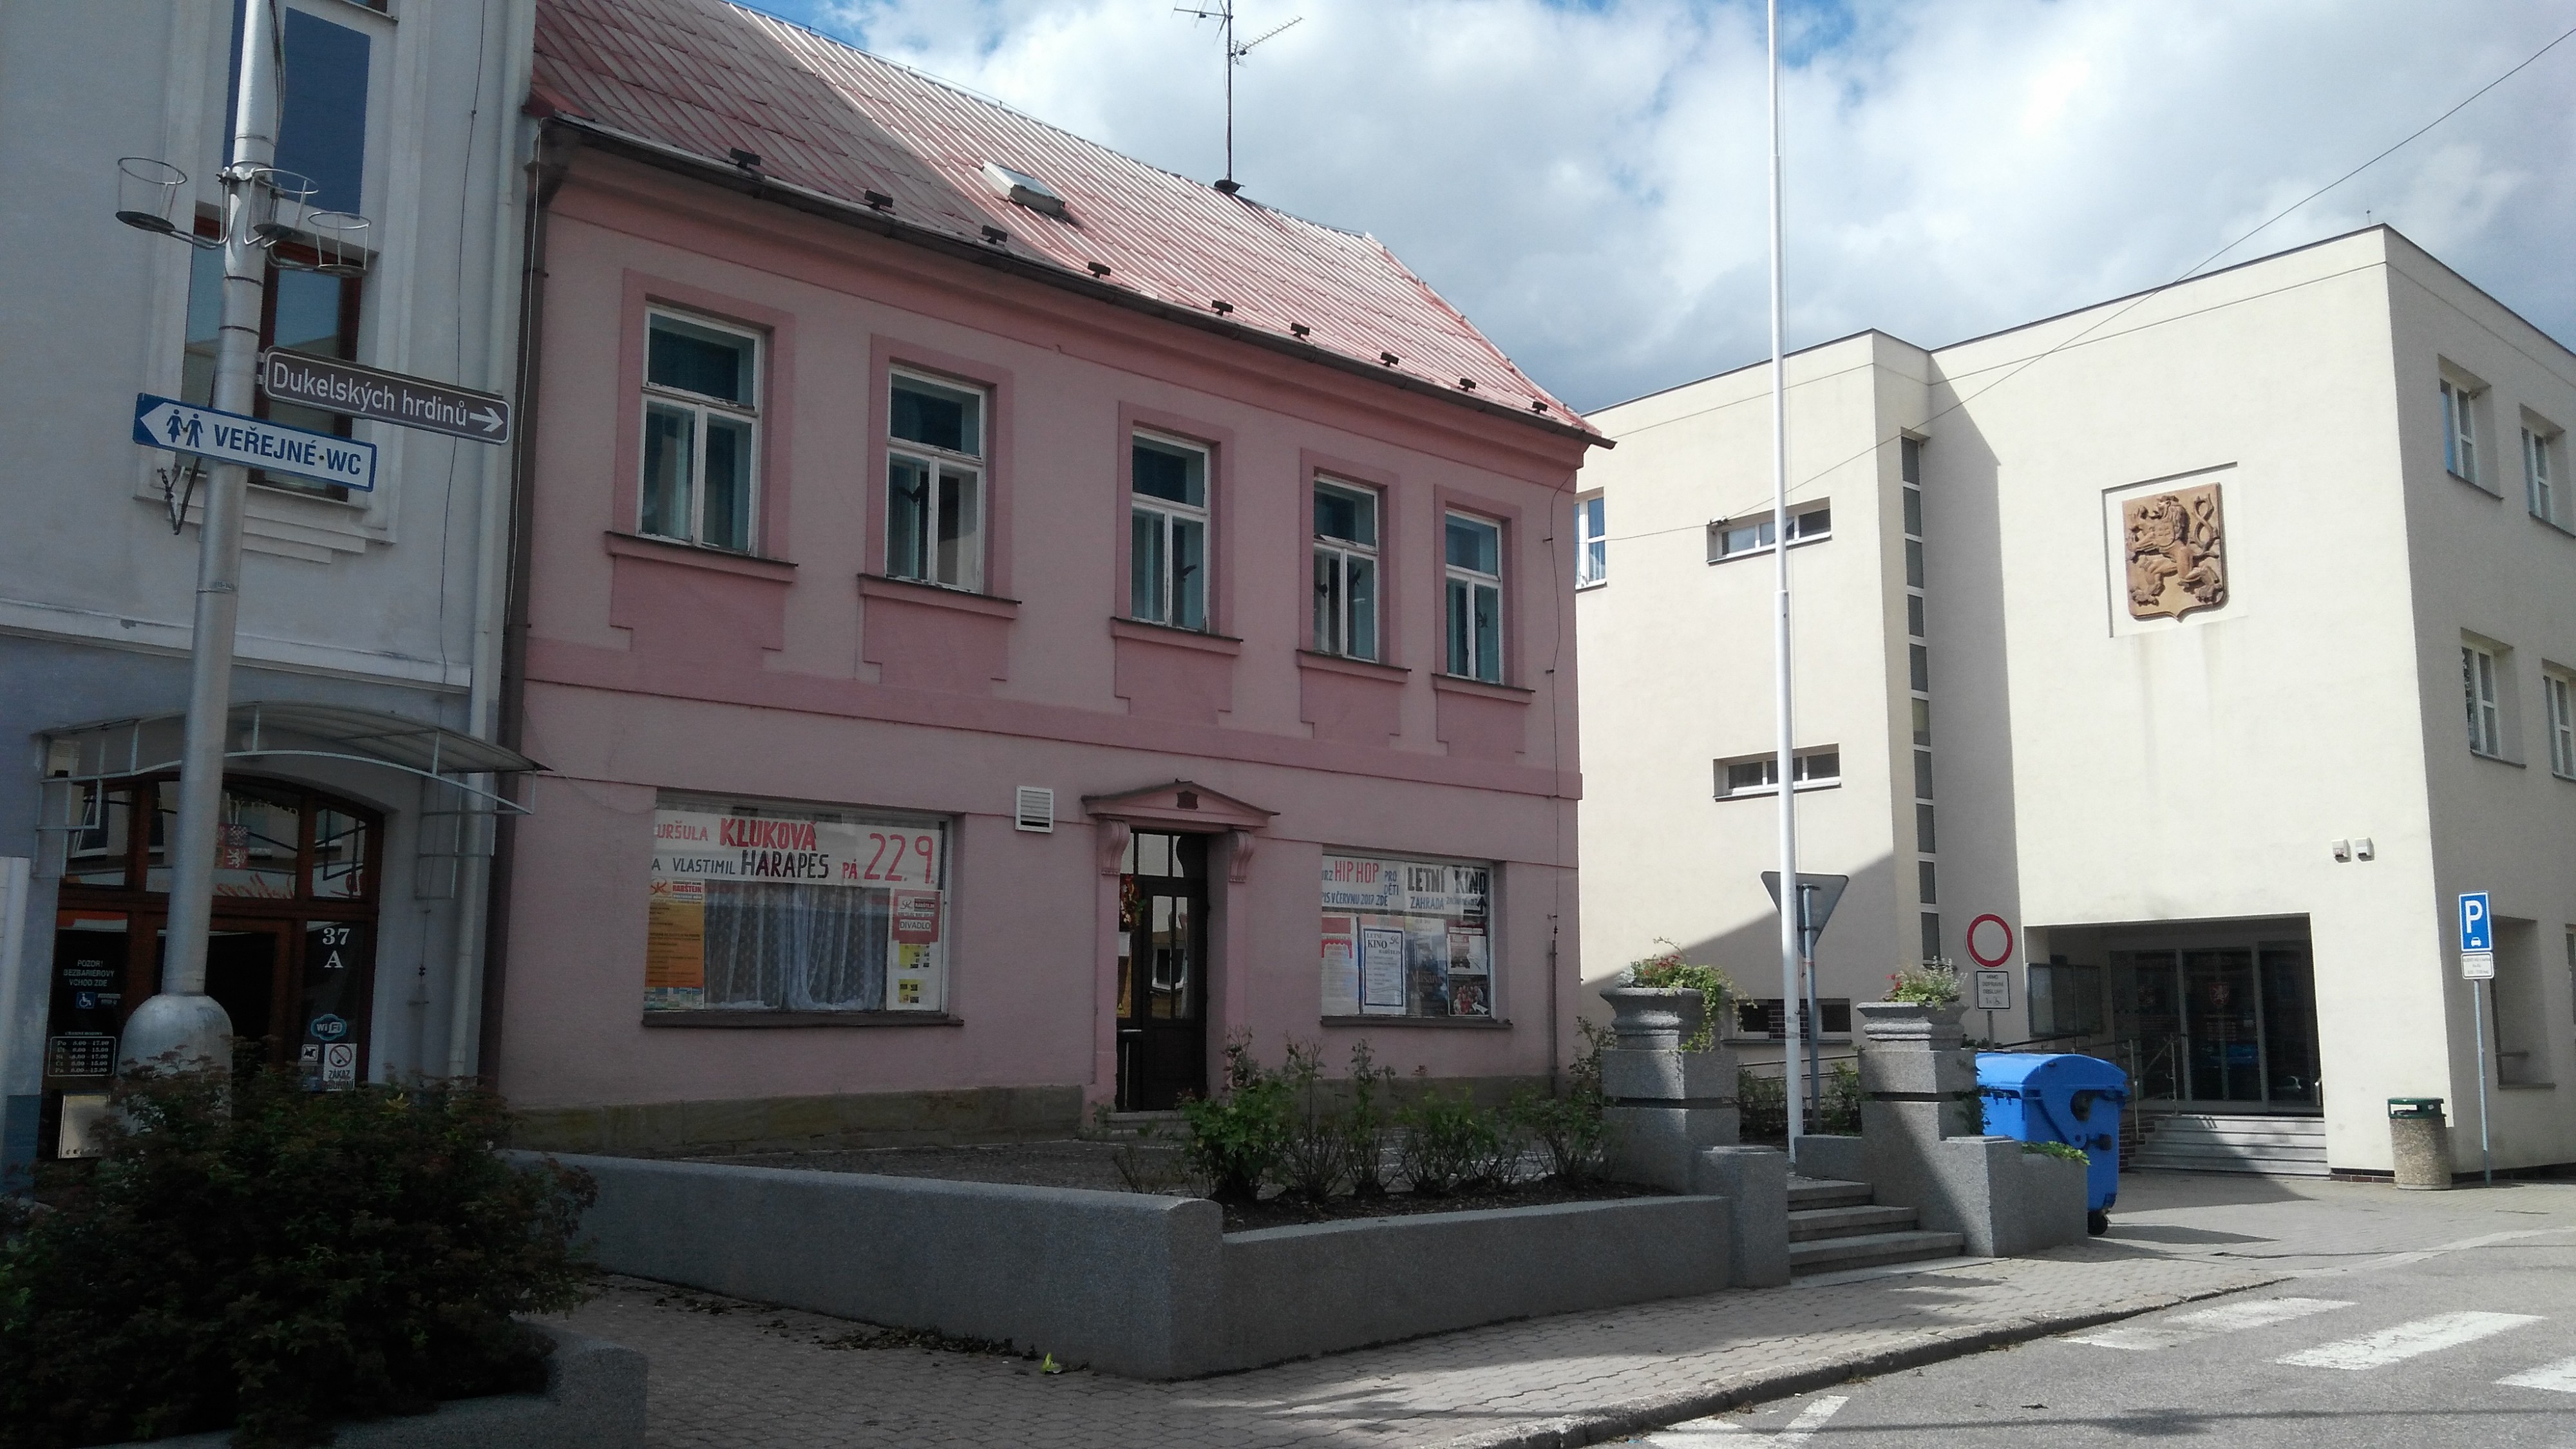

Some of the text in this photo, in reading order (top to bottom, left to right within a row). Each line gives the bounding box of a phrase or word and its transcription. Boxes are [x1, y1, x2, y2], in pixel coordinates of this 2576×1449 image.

[272, 361, 468, 427] Dukelských hrdinů
[214, 424, 361, 475] VEŘEJNÉ WC
[656, 817, 817, 851] URŠULA KLUKOVÁ
[651, 858, 661, 871] A
[672, 857, 735, 875] VLASTIMIL
[740, 849, 829, 879] HARAPES
[842, 858, 858, 880] PÁ
[1334, 860, 1354, 882] HIP
[1356, 861, 1379, 883] HOP
[1384, 870, 1397, 882] PRO
[1384, 882, 1399, 896] DĚTI
[1407, 866, 1486, 895] LETNÍ KINO
[1360, 894, 1374, 905] 2017
[1375, 895, 1388, 906] ZDE
[1410, 896, 1444, 910] ZAHRADA
[900, 920, 931, 931] DIVADLO
[2465, 900, 2483, 934] P
[322, 927, 351, 946] 37
[1367, 940, 1388, 949] KINO
[77, 959, 104, 968] POZOR!
[324, 949, 343, 969] A
[68, 978, 93, 987] VCHOD
